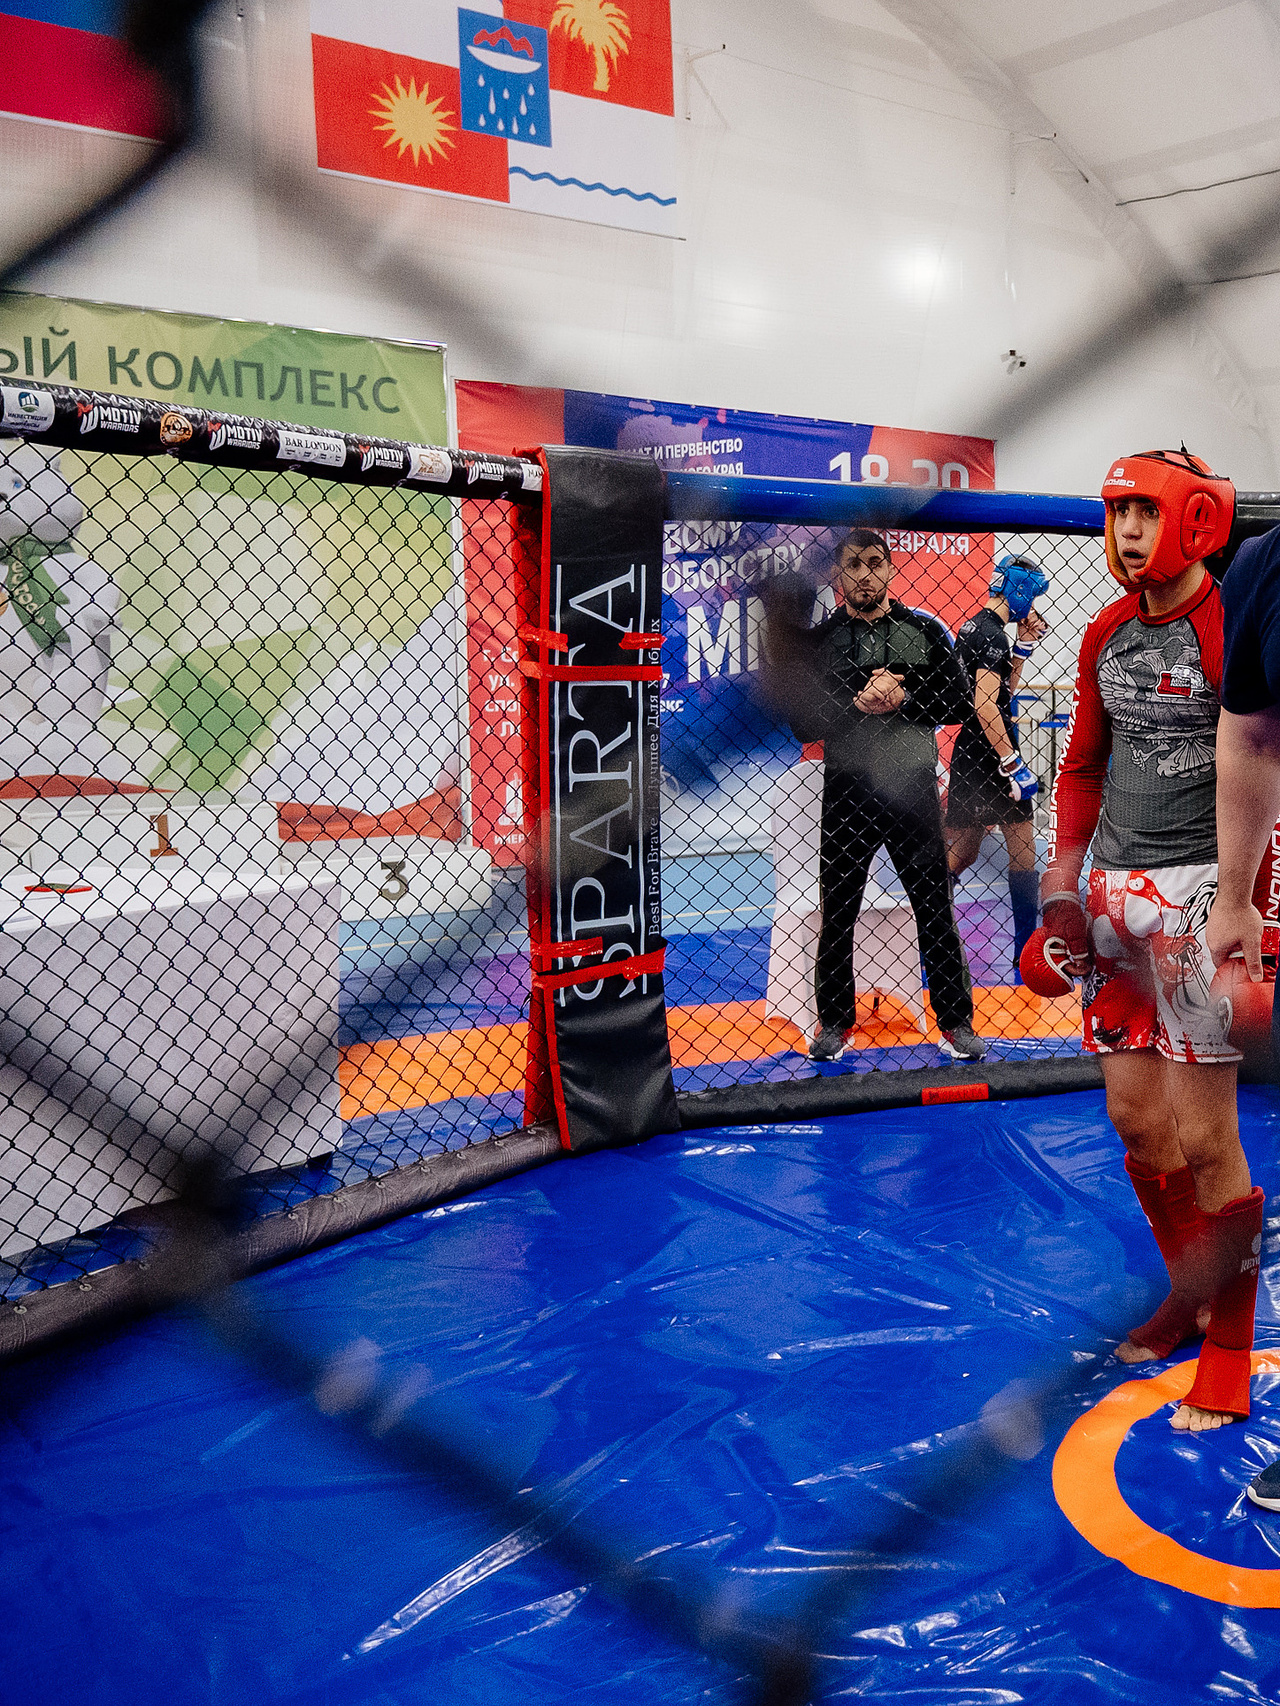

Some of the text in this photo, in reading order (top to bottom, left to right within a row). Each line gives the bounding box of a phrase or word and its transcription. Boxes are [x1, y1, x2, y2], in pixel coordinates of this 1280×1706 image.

[107, 346, 400, 414] КОМПЛЕКС
[100, 407, 142, 424] MOTIV
[100, 421, 140, 433] WARRIORS
[227, 425, 263, 441] MOTIV
[285, 436, 342, 453] BAR LONDON
[375, 447, 404, 461] MOTIV
[654, 446, 663, 460] И
[665, 438, 743, 459] ПЕРВЕНСТВО
[480, 461, 505, 475] MOTIV
[872, 528, 969, 556] ЕВРАЛЯ
[647, 695, 660, 728] Для
[150, 814, 179, 857] 1
[380, 859, 408, 901] 3
[647, 817, 660, 936] Best For Brave
